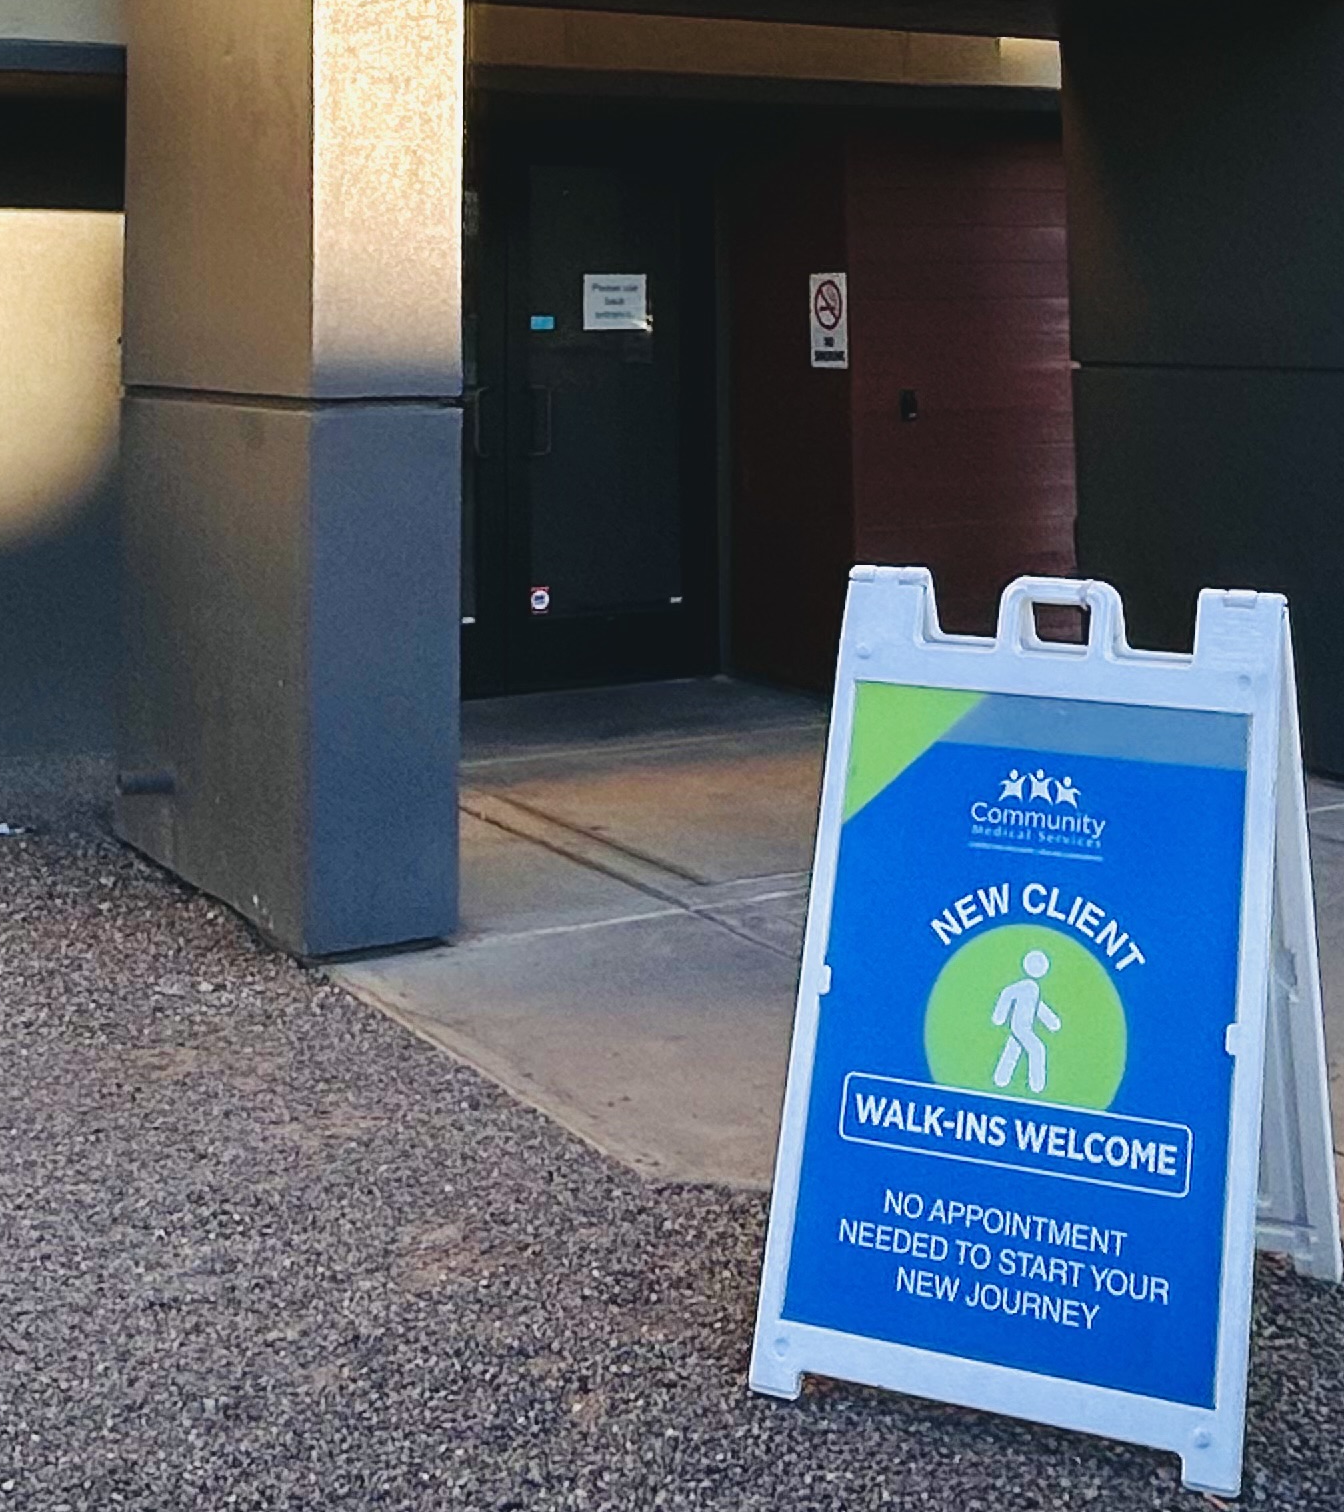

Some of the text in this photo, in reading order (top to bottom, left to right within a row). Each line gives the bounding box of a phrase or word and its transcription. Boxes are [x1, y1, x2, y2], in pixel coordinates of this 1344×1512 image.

[970, 801, 1107, 840] Community
[970, 824, 1103, 849] Medical Services
[930, 882, 1146, 971] NEW CLIENT
[856, 1092, 1179, 1176] WALK-INS WELCOME
[883, 1188, 1128, 1257] NO APPOINTMENT
[838, 1218, 1171, 1306] NEEDED TO START YOUR
[896, 1265, 1101, 1330] NEW JOURNEY
